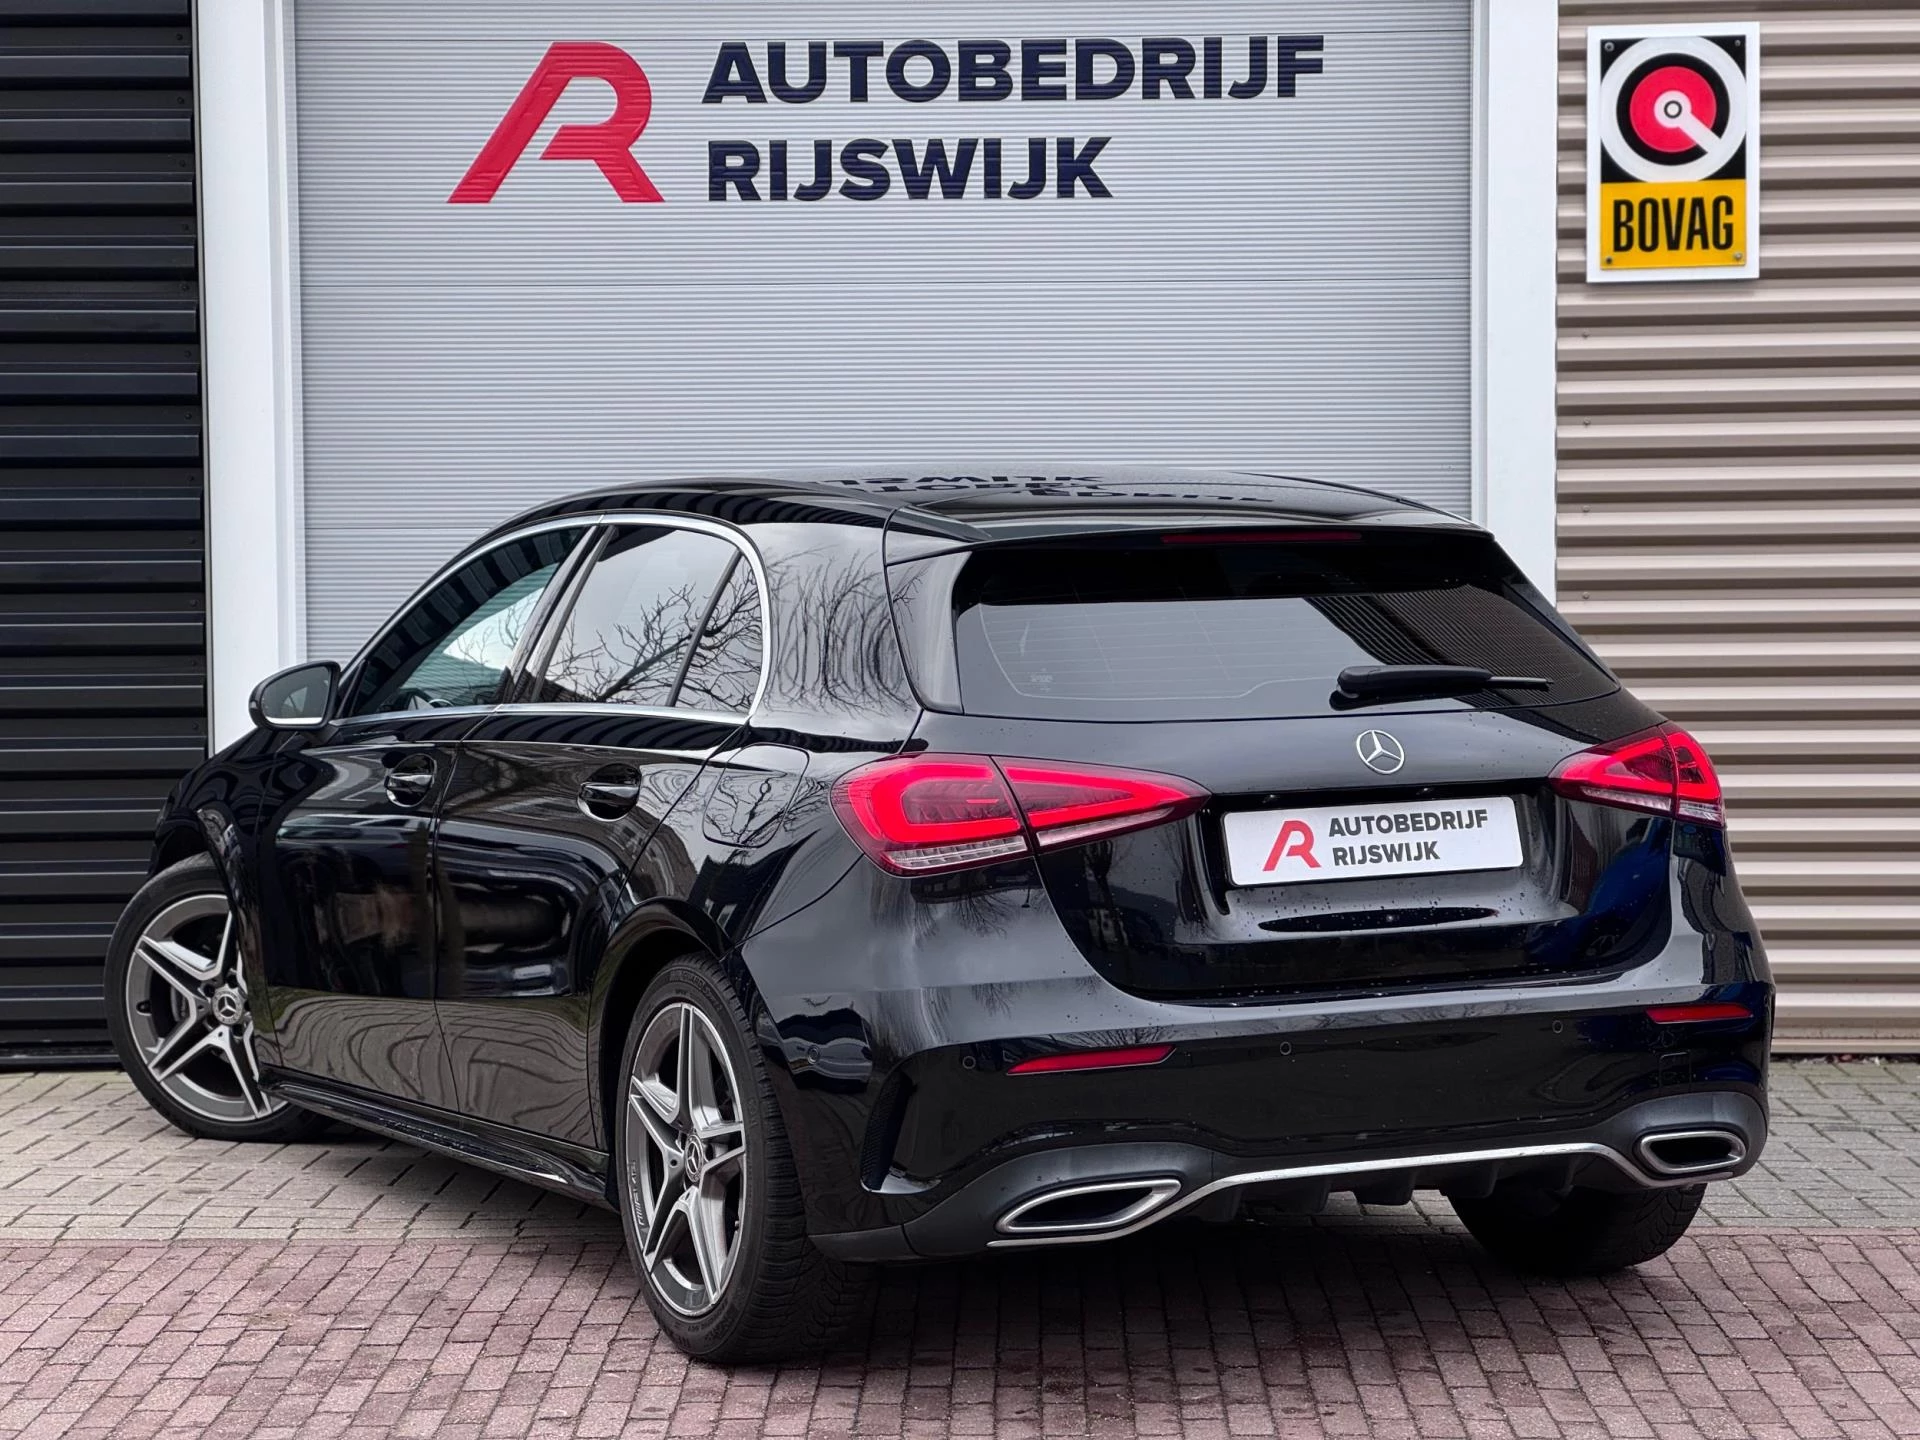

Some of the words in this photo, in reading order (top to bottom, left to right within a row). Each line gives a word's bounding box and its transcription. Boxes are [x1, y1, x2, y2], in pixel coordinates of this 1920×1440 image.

[702, 35, 1324, 104] AUTOBEDRIJF
[708, 136, 1113, 202] RIJSWIJK
[1613, 195, 1734, 253] BOVAG
[1328, 808, 1489, 838] AUTOBEDRIJF
[1332, 841, 1440, 866] RIJSWIJK
